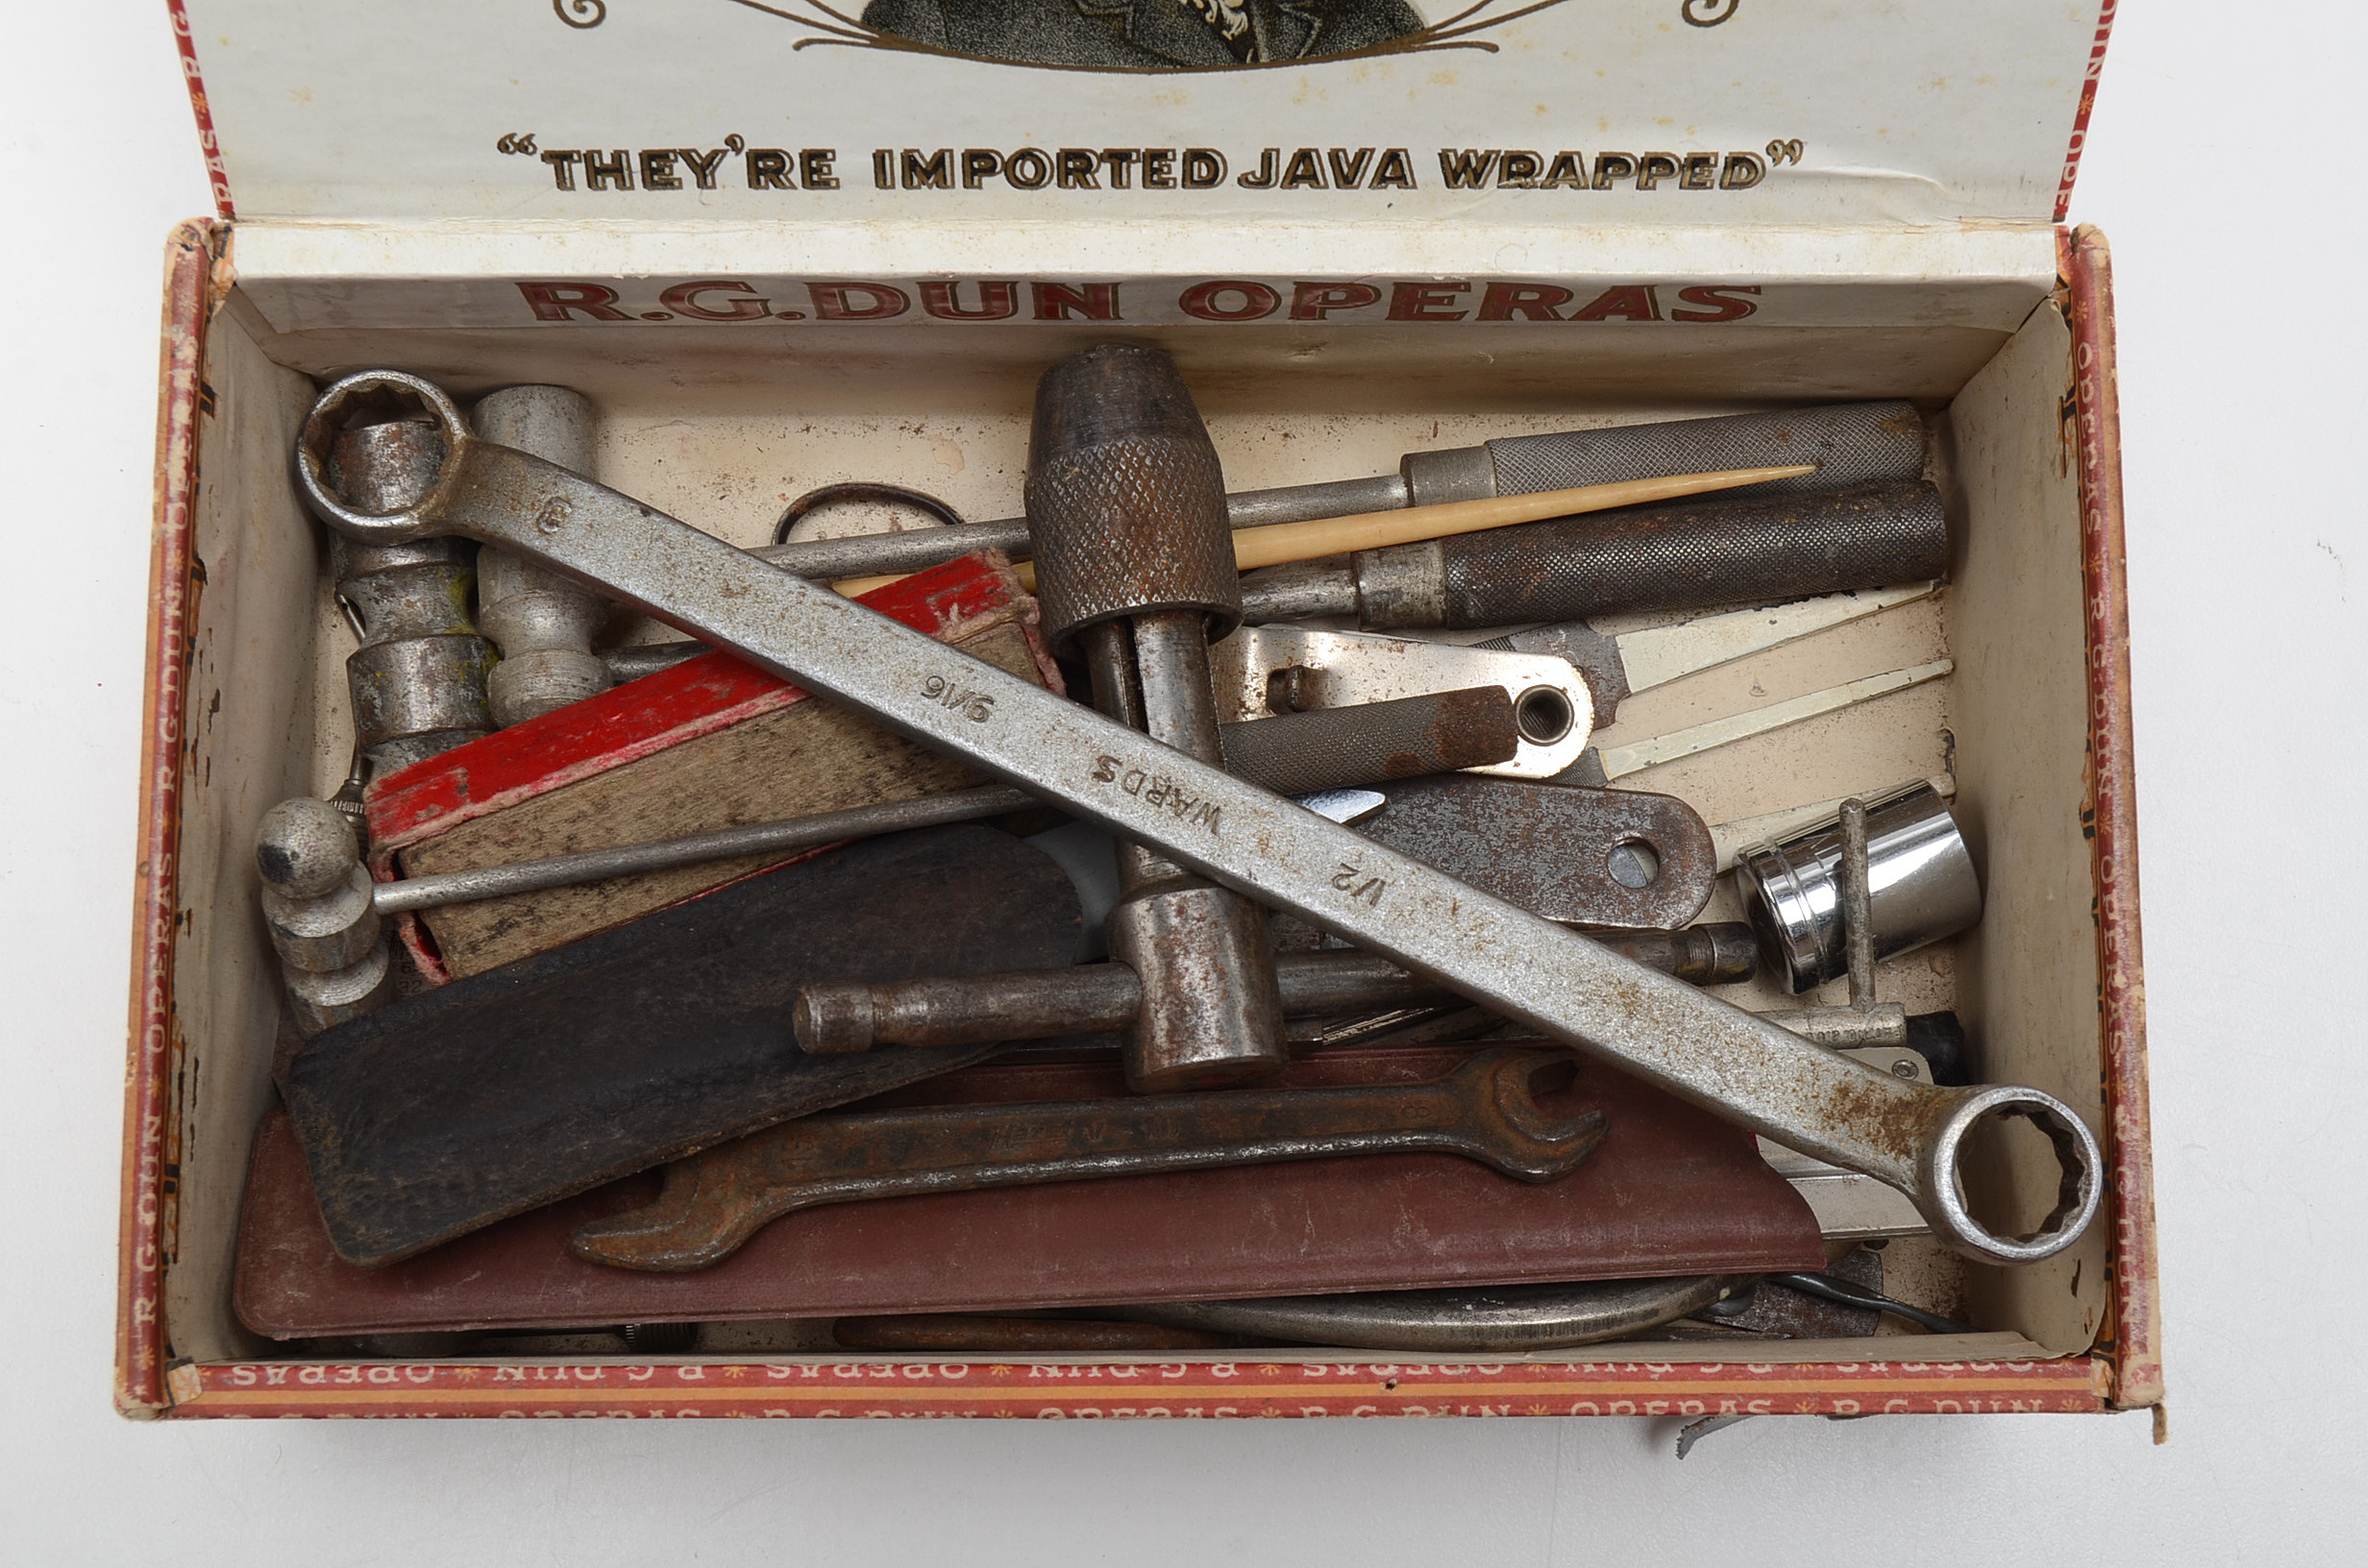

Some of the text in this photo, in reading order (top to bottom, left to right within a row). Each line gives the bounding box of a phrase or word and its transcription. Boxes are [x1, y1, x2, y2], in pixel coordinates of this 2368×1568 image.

[873, 147, 1228, 191] IMPORTED
[1237, 147, 1419, 191] JAVA
[1178, 280, 1763, 323] OPERAS
[2077, 341, 2102, 535] OPERAS
[920, 674, 1390, 908] 1/2 WARDS 9/16
[147, 853, 173, 1053] OPERAS
[232, 1365, 435, 1385] OPERAS
